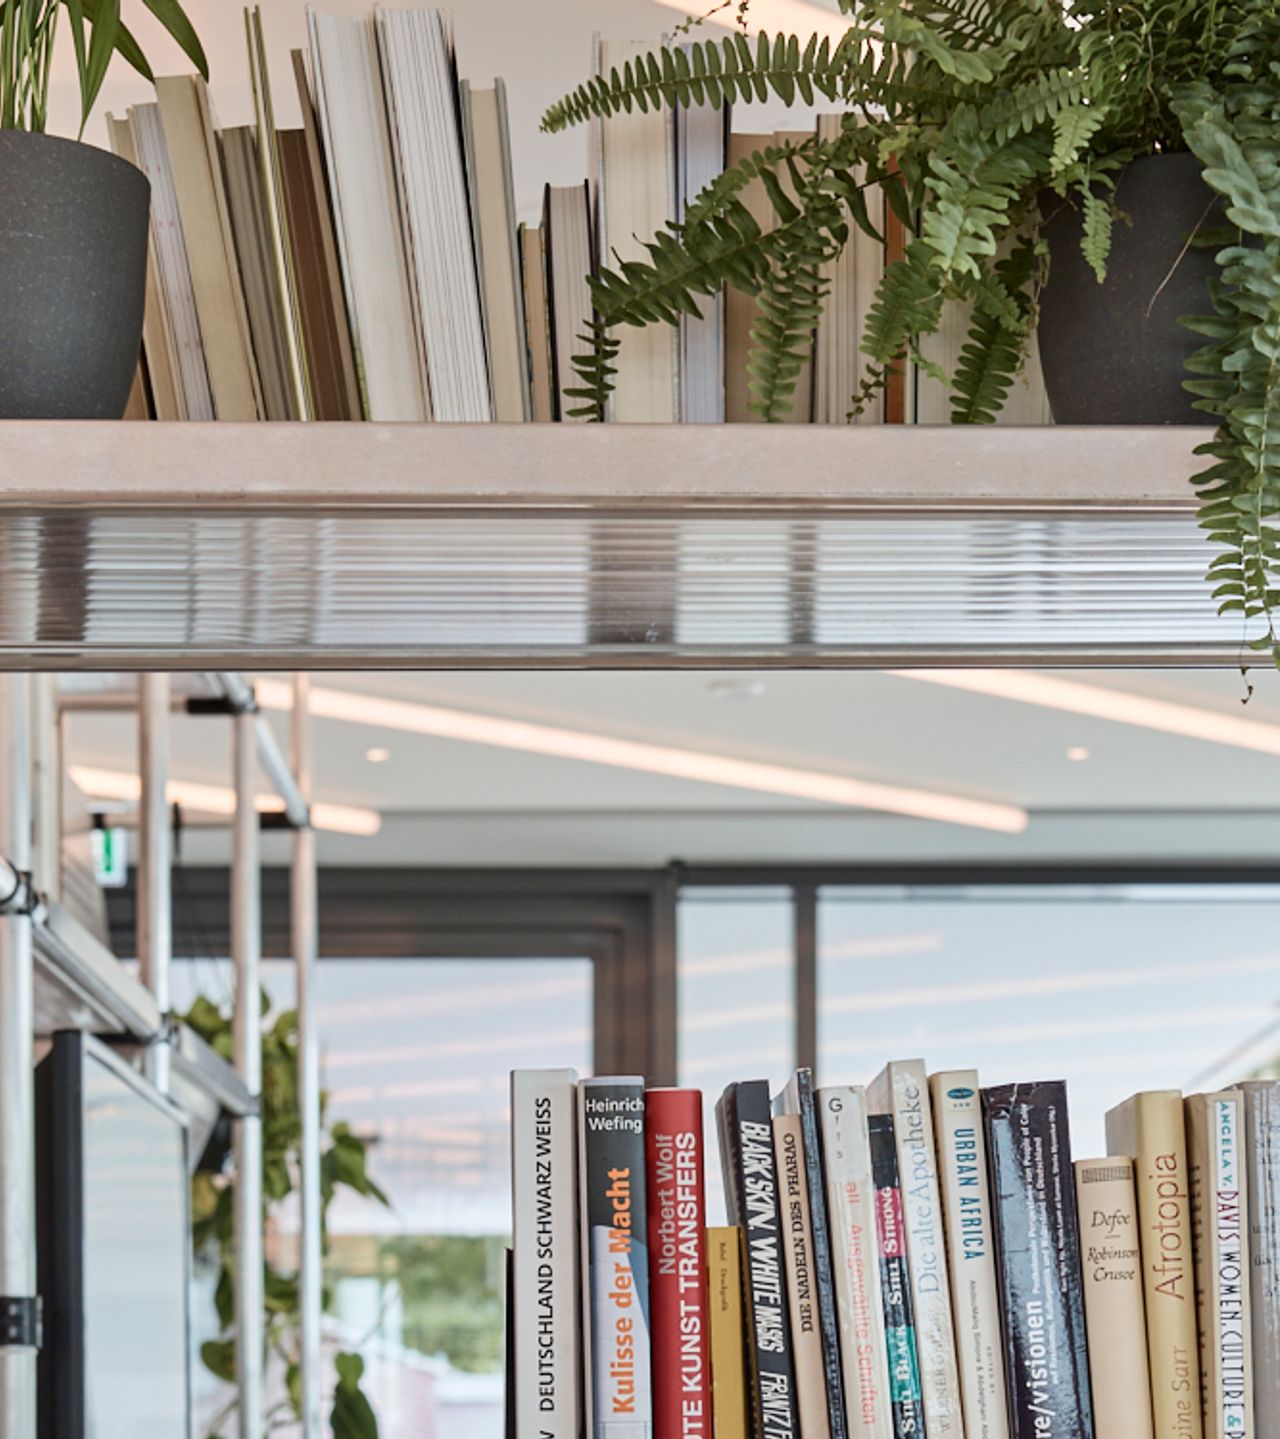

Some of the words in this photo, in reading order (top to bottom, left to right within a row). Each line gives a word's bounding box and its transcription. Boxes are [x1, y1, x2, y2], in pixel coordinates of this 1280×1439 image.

[535, 1097, 552, 1158] WEISS
[586, 1097, 644, 1113] Heinrich
[588, 1115, 642, 1133] Wefing
[655, 1134, 674, 1184] Wolf
[740, 1120, 773, 1181] BLACK
[783, 1133, 801, 1197] PHARAO
[900, 1087, 933, 1202] Apotheke
[954, 1127, 980, 1187] URBAN
[1220, 1103, 1234, 1169] ANGELA
[536, 1162, 553, 1259] SCHWARZ
[606, 1167, 632, 1254] Macht
[1221, 1173, 1233, 1188] Y.
[657, 1188, 676, 1275] Norbert
[675, 1132, 700, 1294] TRANSFERS
[790, 1201, 805, 1233] DES
[879, 1186, 899, 1254] STRONG
[913, 1206, 935, 1247] alte
[959, 1196, 986, 1260] AFRICA
[1149, 1152, 1187, 1301] Afrotopia
[1217, 1190, 1240, 1242] DAVIS
[609, 1262, 632, 1308] der
[749, 1236, 782, 1305] WHITE
[794, 1238, 811, 1300] NADELN
[918, 1254, 940, 1294] Die
[1087, 1246, 1139, 1265] Robinson
[1092, 1266, 1136, 1283] Crusoe
[799, 1303, 814, 1333] DIE
[1219, 1249, 1242, 1328] WOMEN,
[537, 1264, 555, 1412] DEUTSCHLAND
[679, 1300, 702, 1392] KUNST
[753, 1304, 785, 1353] MASKS
[610, 1317, 635, 1413] Kulisse
[856, 1343, 878, 1425] Schriften
[1024, 1301, 1056, 1439] re/visionen
[1171, 1345, 1190, 1393] Sarr
[1221, 1330, 1246, 1410] CULTURE
[759, 1370, 792, 1431] FRANTZ
[1226, 1414, 1242, 1429] &
